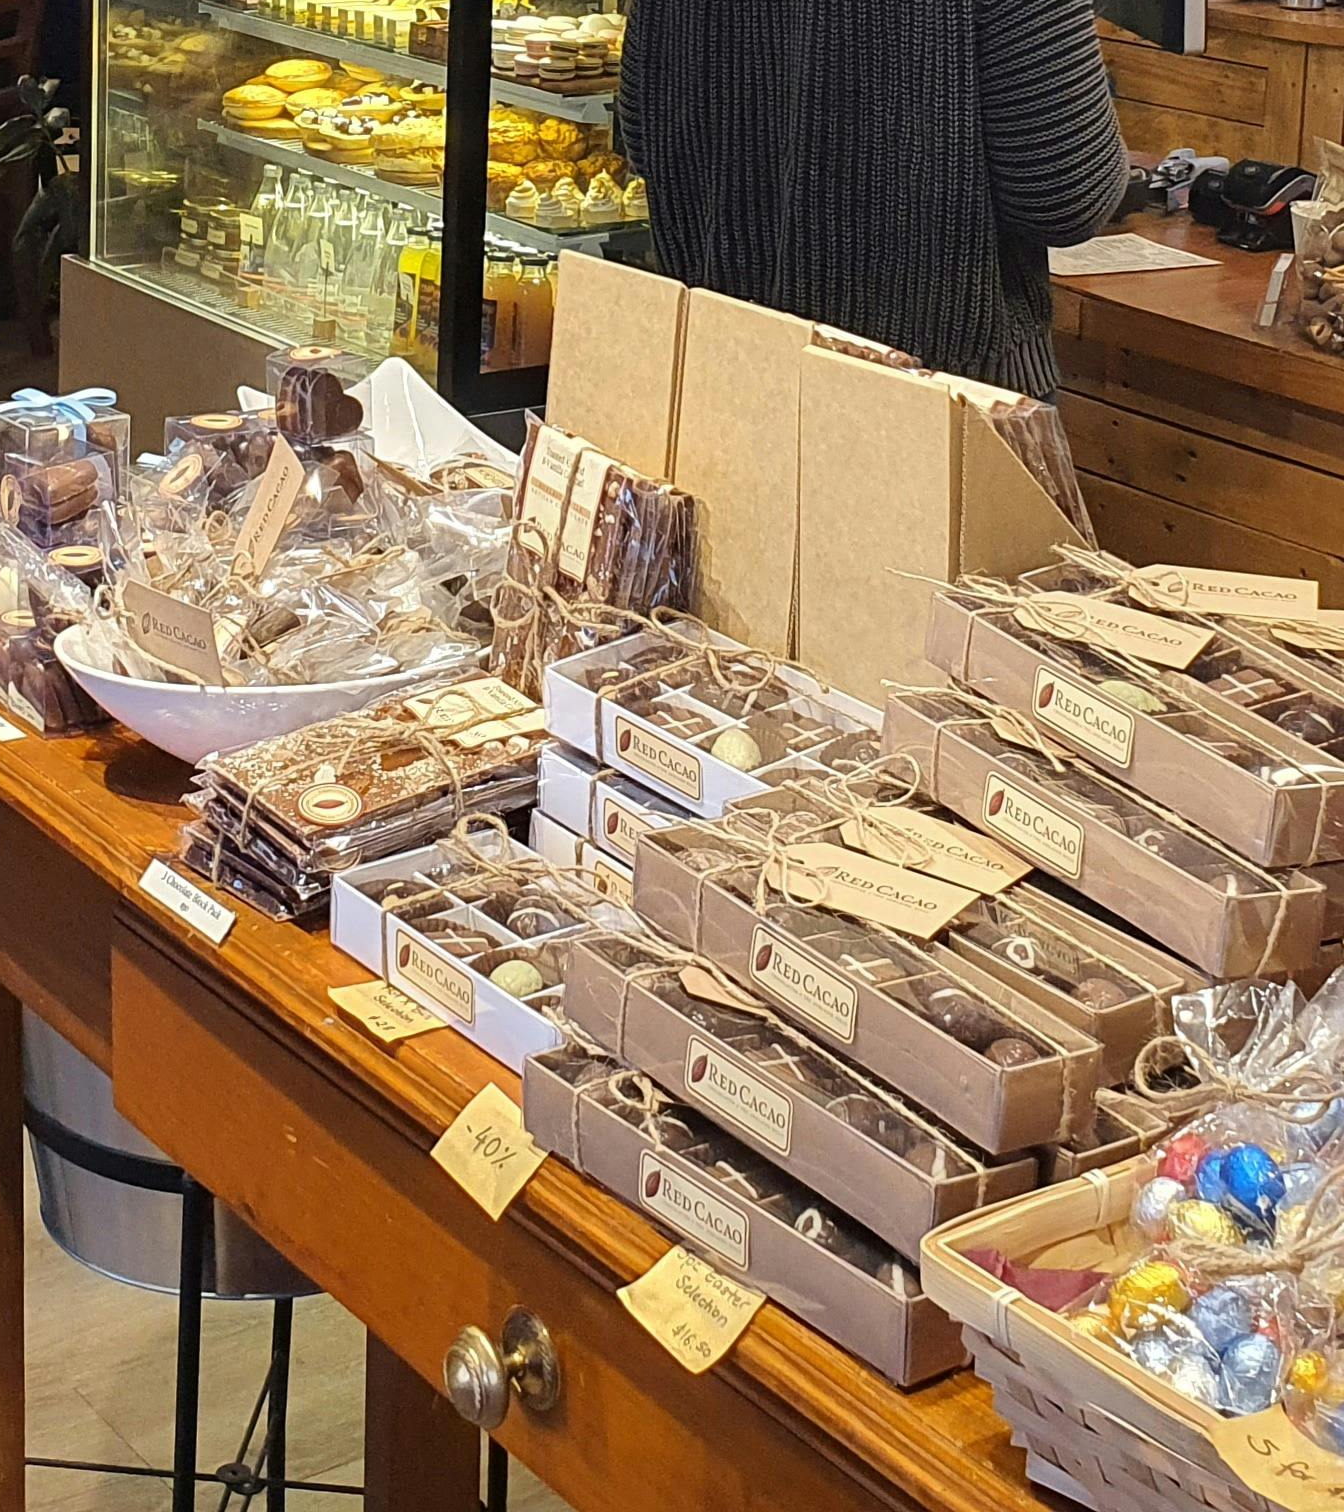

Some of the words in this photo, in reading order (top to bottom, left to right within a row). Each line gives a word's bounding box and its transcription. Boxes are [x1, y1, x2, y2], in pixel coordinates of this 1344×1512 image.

[268, 466, 289, 512] CACAO
[1192, 582, 1232, 594] RED
[1234, 587, 1298, 600] CACAO
[152, 615, 172, 637] RED
[173, 626, 206, 650] CACAO
[1122, 625, 1183, 646] CACAO
[1054, 688, 1082, 718] RED
[1083, 706, 1127, 744] CACAO
[633, 734, 657, 760] RED
[658, 750, 697, 783] CACAO
[1004, 796, 1031, 827] RED
[1033, 815, 1077, 856] CACAO
[947, 845, 1005, 871] CACAO
[834, 870, 873, 891] RED
[876, 885, 939, 911] CACAO
[411, 950, 434, 978] RED
[434, 968, 470, 1005] CACAO
[772, 951, 801, 986] RED
[802, 974, 850, 1018] CACAO
[708, 1061, 737, 1095] RED
[739, 1084, 786, 1129] CACAO
[662, 1177, 692, 1212] RED
[694, 1200, 743, 1246] CACAO
[1247, 1434, 1280, 1456] 5
